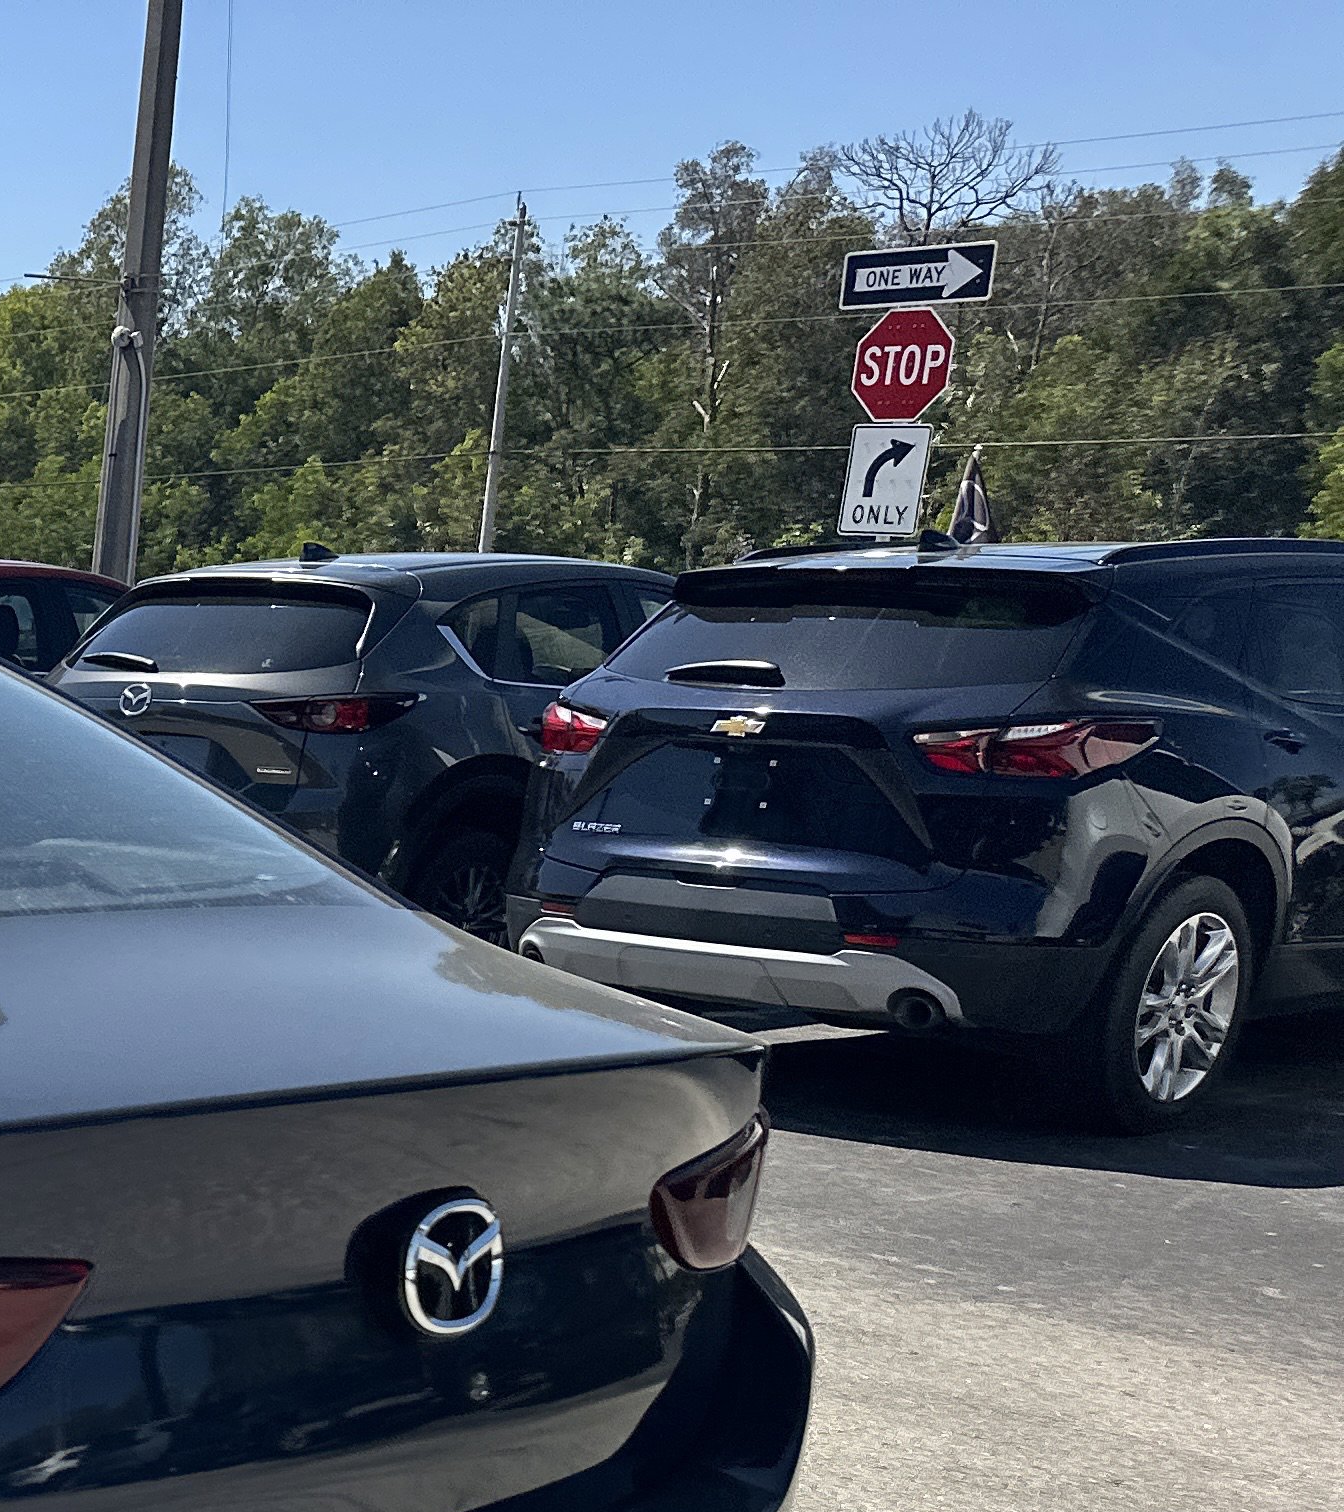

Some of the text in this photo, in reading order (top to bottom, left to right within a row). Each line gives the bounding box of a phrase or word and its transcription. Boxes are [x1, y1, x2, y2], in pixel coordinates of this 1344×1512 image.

[866, 265, 946, 288] ONE WAY
[860, 345, 946, 386] STOP
[852, 504, 909, 526] ONLY
[572, 821, 622, 834] BLAZER
